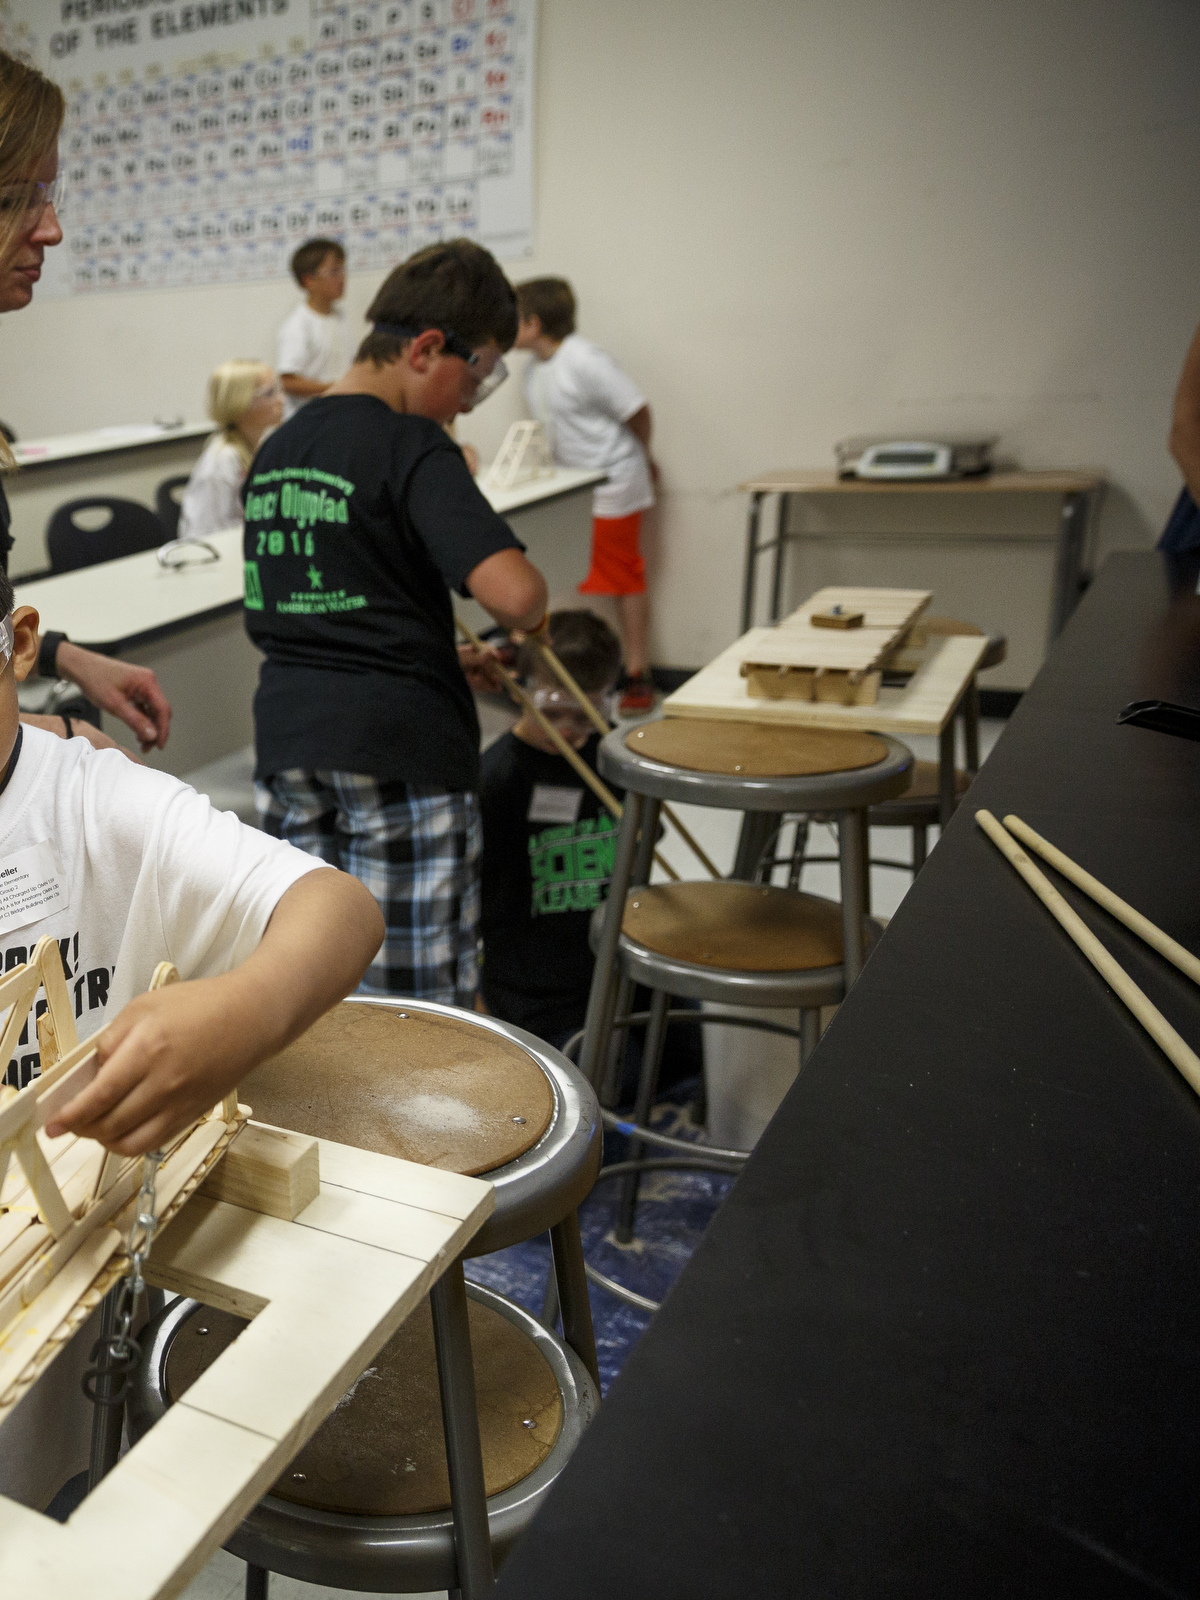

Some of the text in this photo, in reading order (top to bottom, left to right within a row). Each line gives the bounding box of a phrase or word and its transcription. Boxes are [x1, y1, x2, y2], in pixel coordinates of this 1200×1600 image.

[49, 0, 289, 58] OF THE ELEMENTS
[256, 531, 315, 557] 2016
[74, 966, 116, 1020] TR
